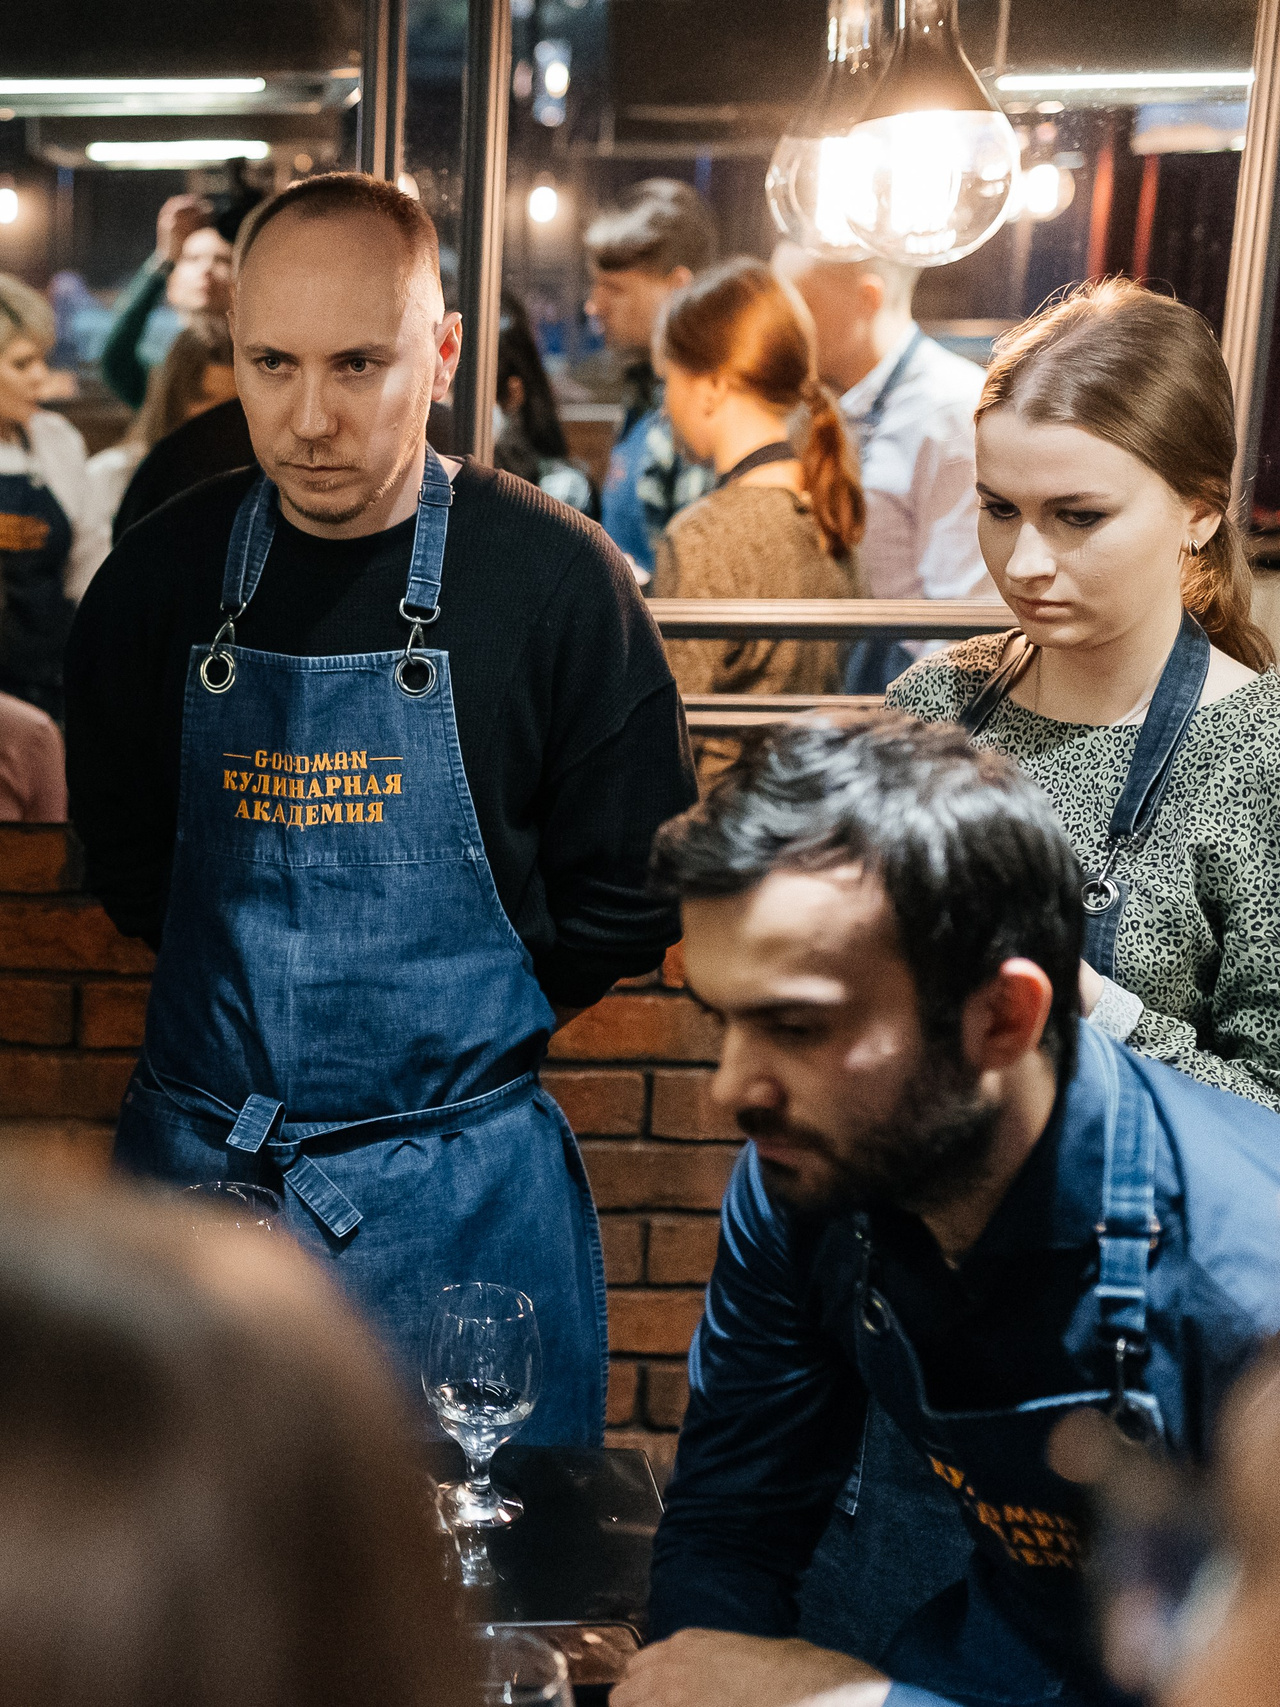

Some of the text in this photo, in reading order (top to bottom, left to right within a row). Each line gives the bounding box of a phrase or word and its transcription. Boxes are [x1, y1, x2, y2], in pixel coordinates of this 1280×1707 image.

[254, 750, 368, 774] GOODMAN
[223, 770, 403, 799] КУЛИНАРНАЯ
[234, 798, 384, 832] АКАДЕМИЯ
